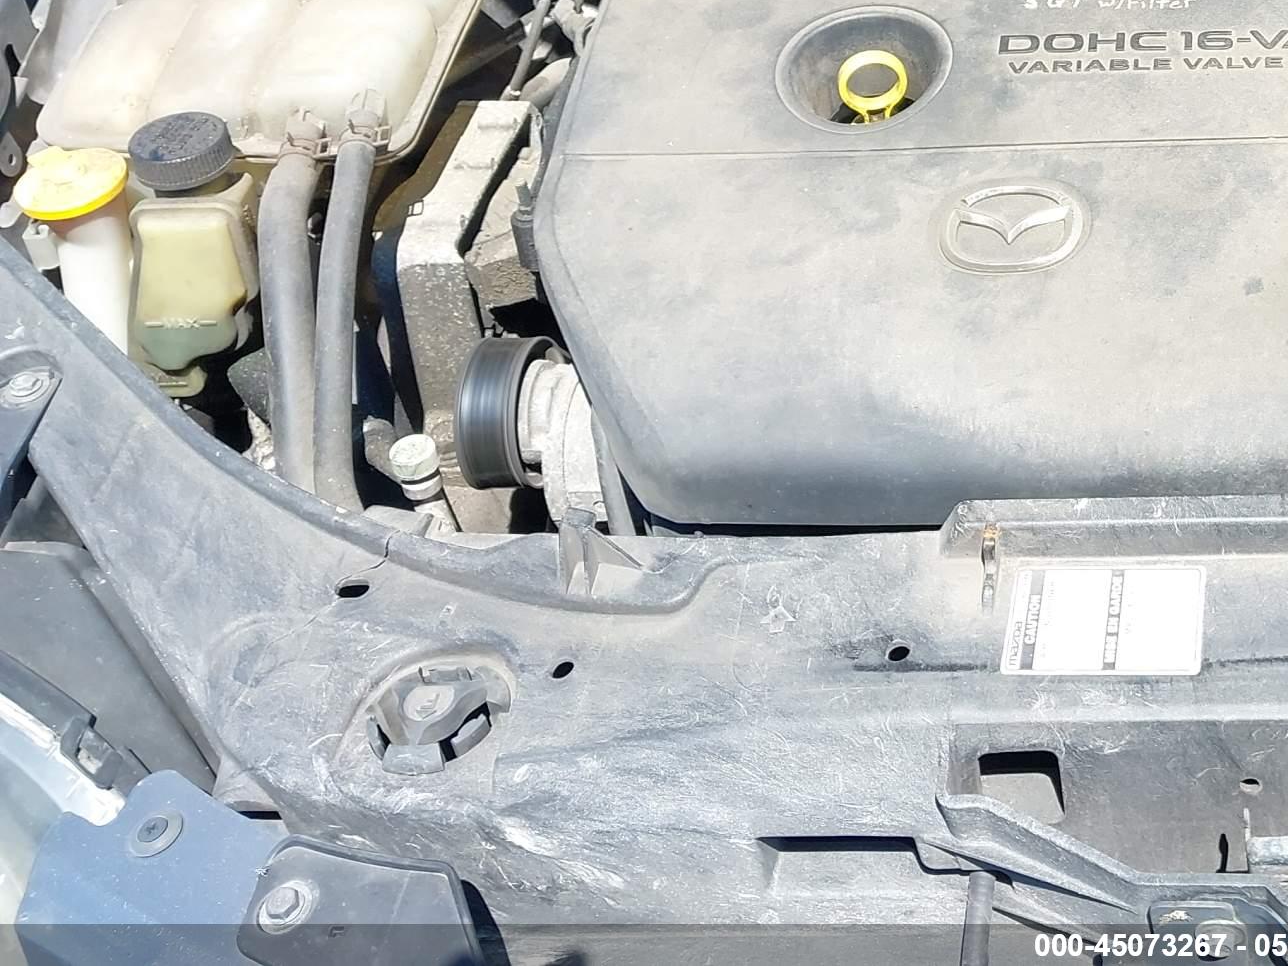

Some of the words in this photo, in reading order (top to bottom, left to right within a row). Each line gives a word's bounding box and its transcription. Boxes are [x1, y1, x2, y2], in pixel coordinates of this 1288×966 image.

[998, 31, 1168, 55] DOHC
[1008, 57, 1173, 75] VARIABLE
[1183, 56, 1284, 70] VALVE
[1109, 575, 1124, 615] GARDE
[1023, 593, 1043, 645] CAUTION
[1106, 616, 1119, 634] EN
[1008, 621, 1024, 666] mazda
[1103, 634, 1118, 663] MISE
